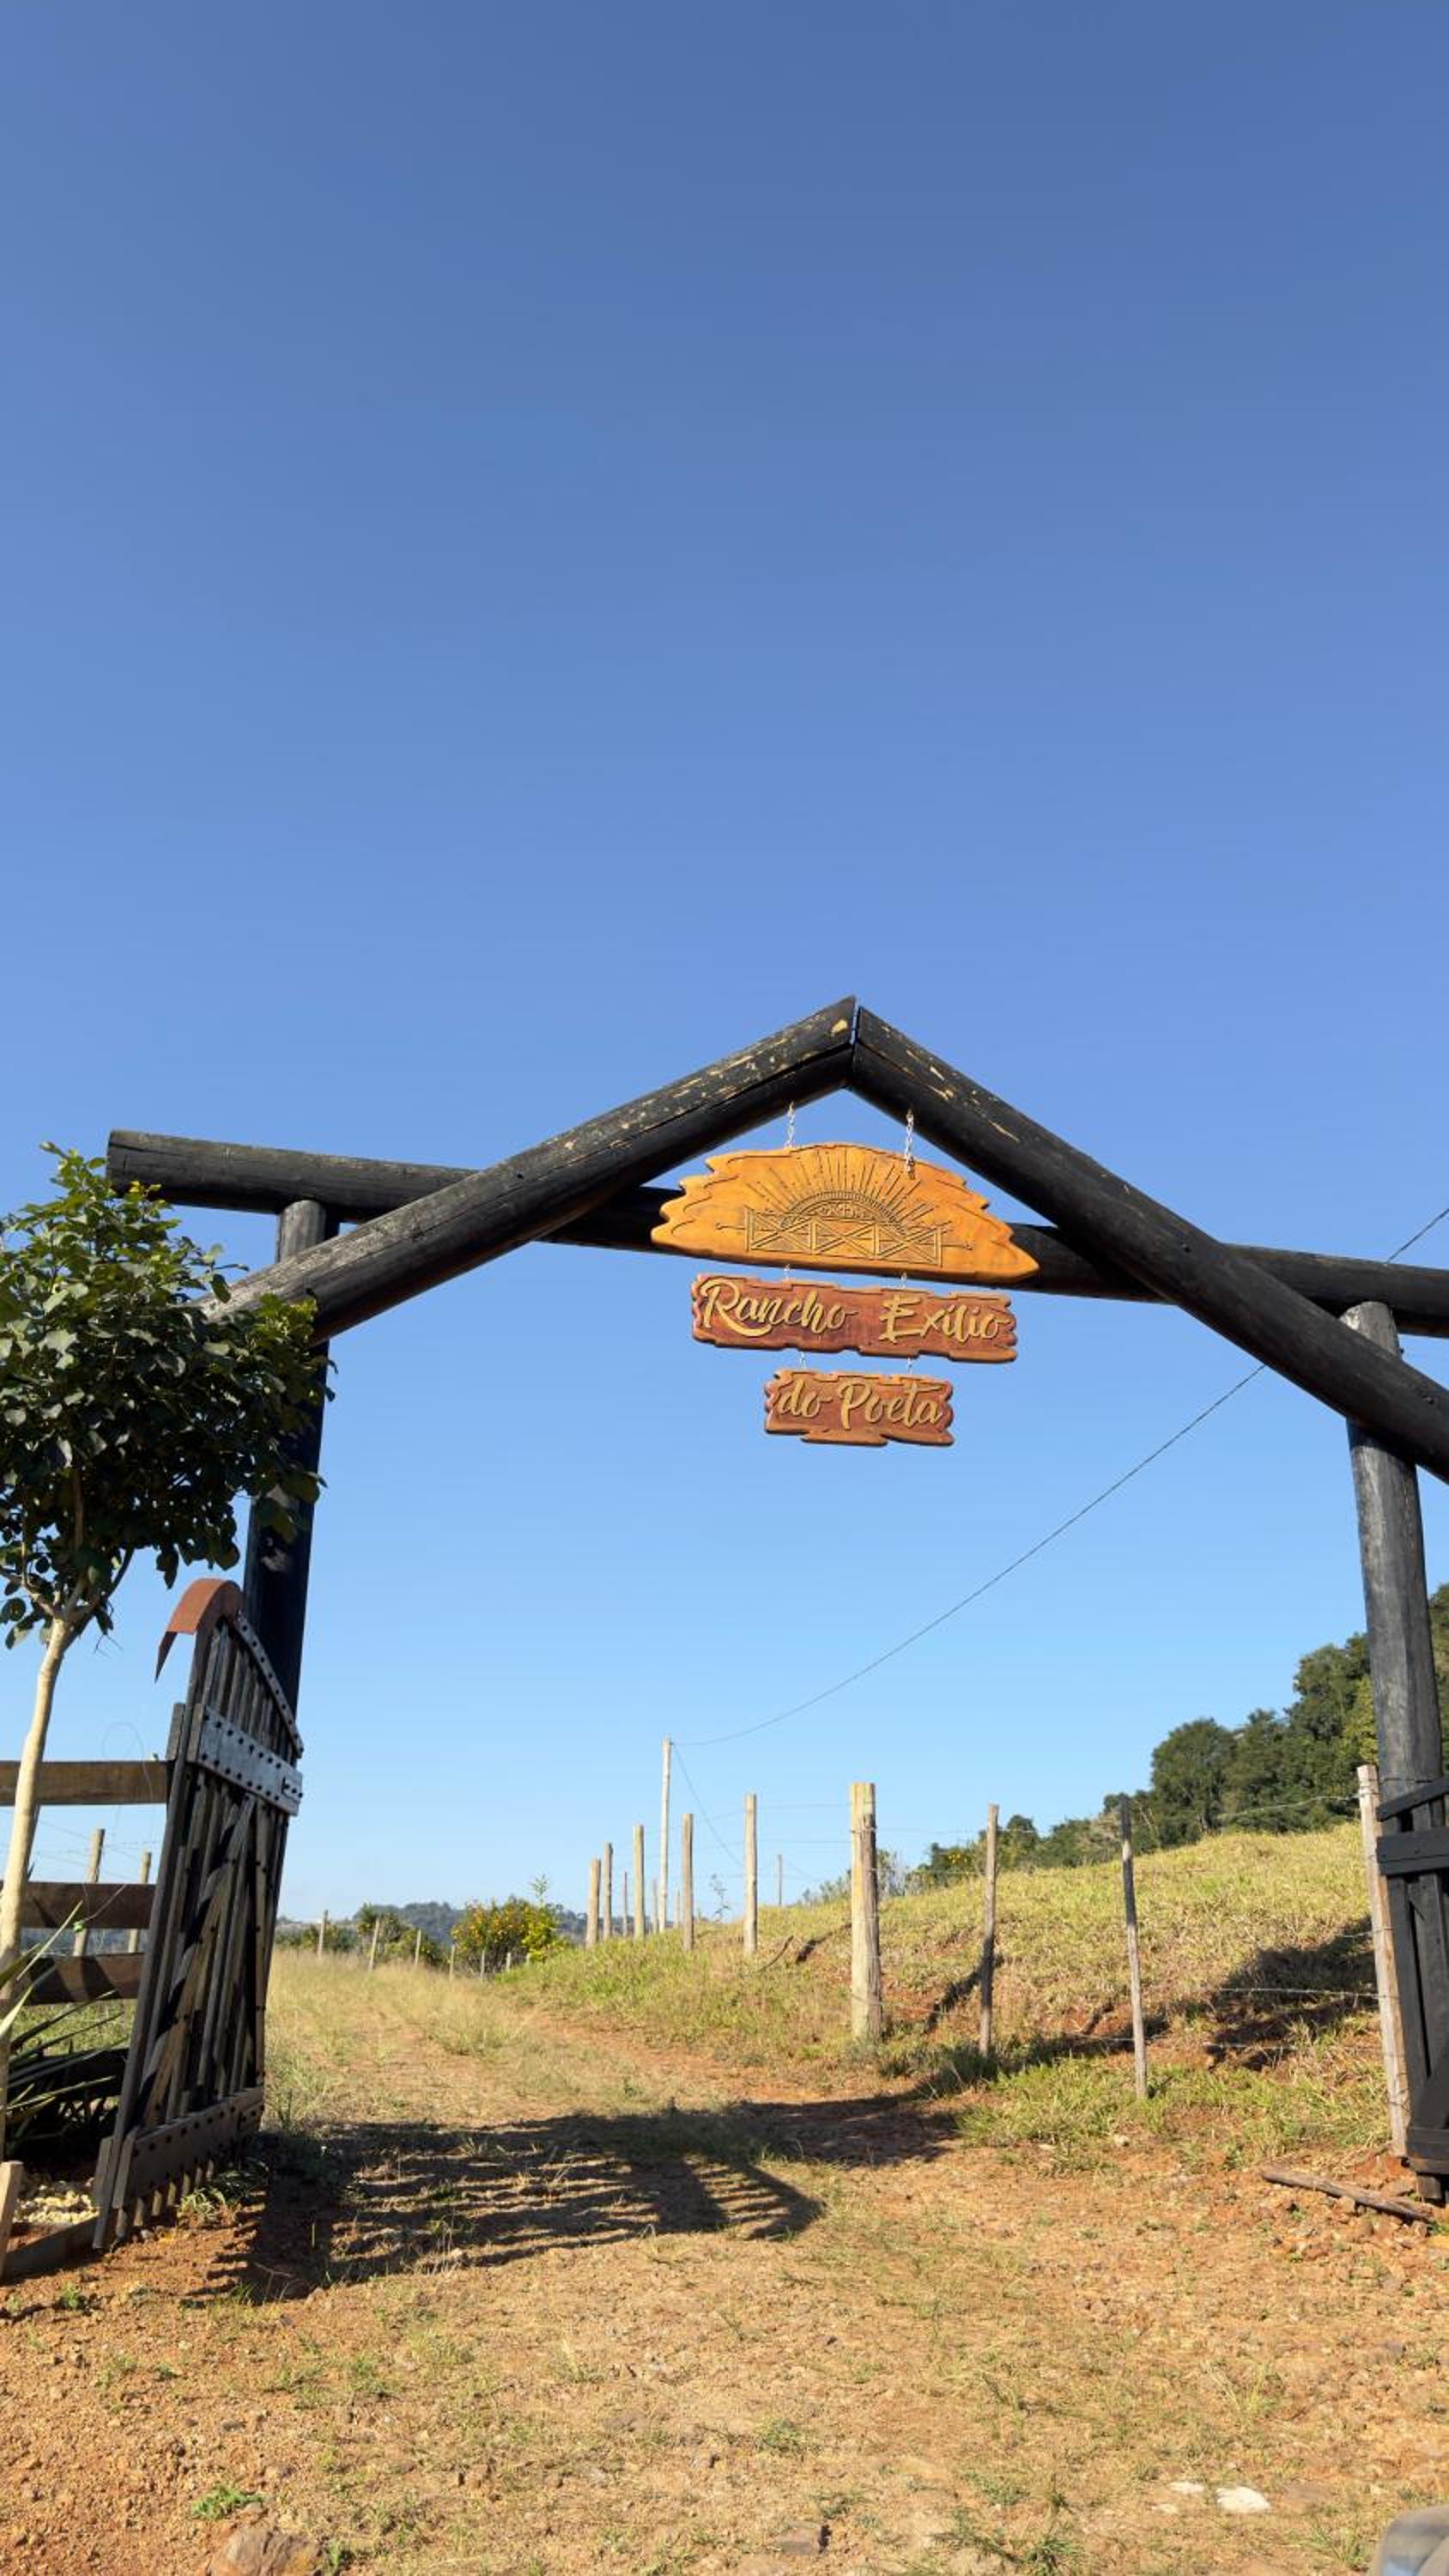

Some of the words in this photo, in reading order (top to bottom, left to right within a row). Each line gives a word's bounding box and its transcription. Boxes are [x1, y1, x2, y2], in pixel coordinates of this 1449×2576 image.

[700, 1279, 858, 1337] Rancho
[878, 1295, 1010, 1344] Exílio
[777, 1380, 833, 1419] do
[839, 1382, 943, 1430] Poeta
